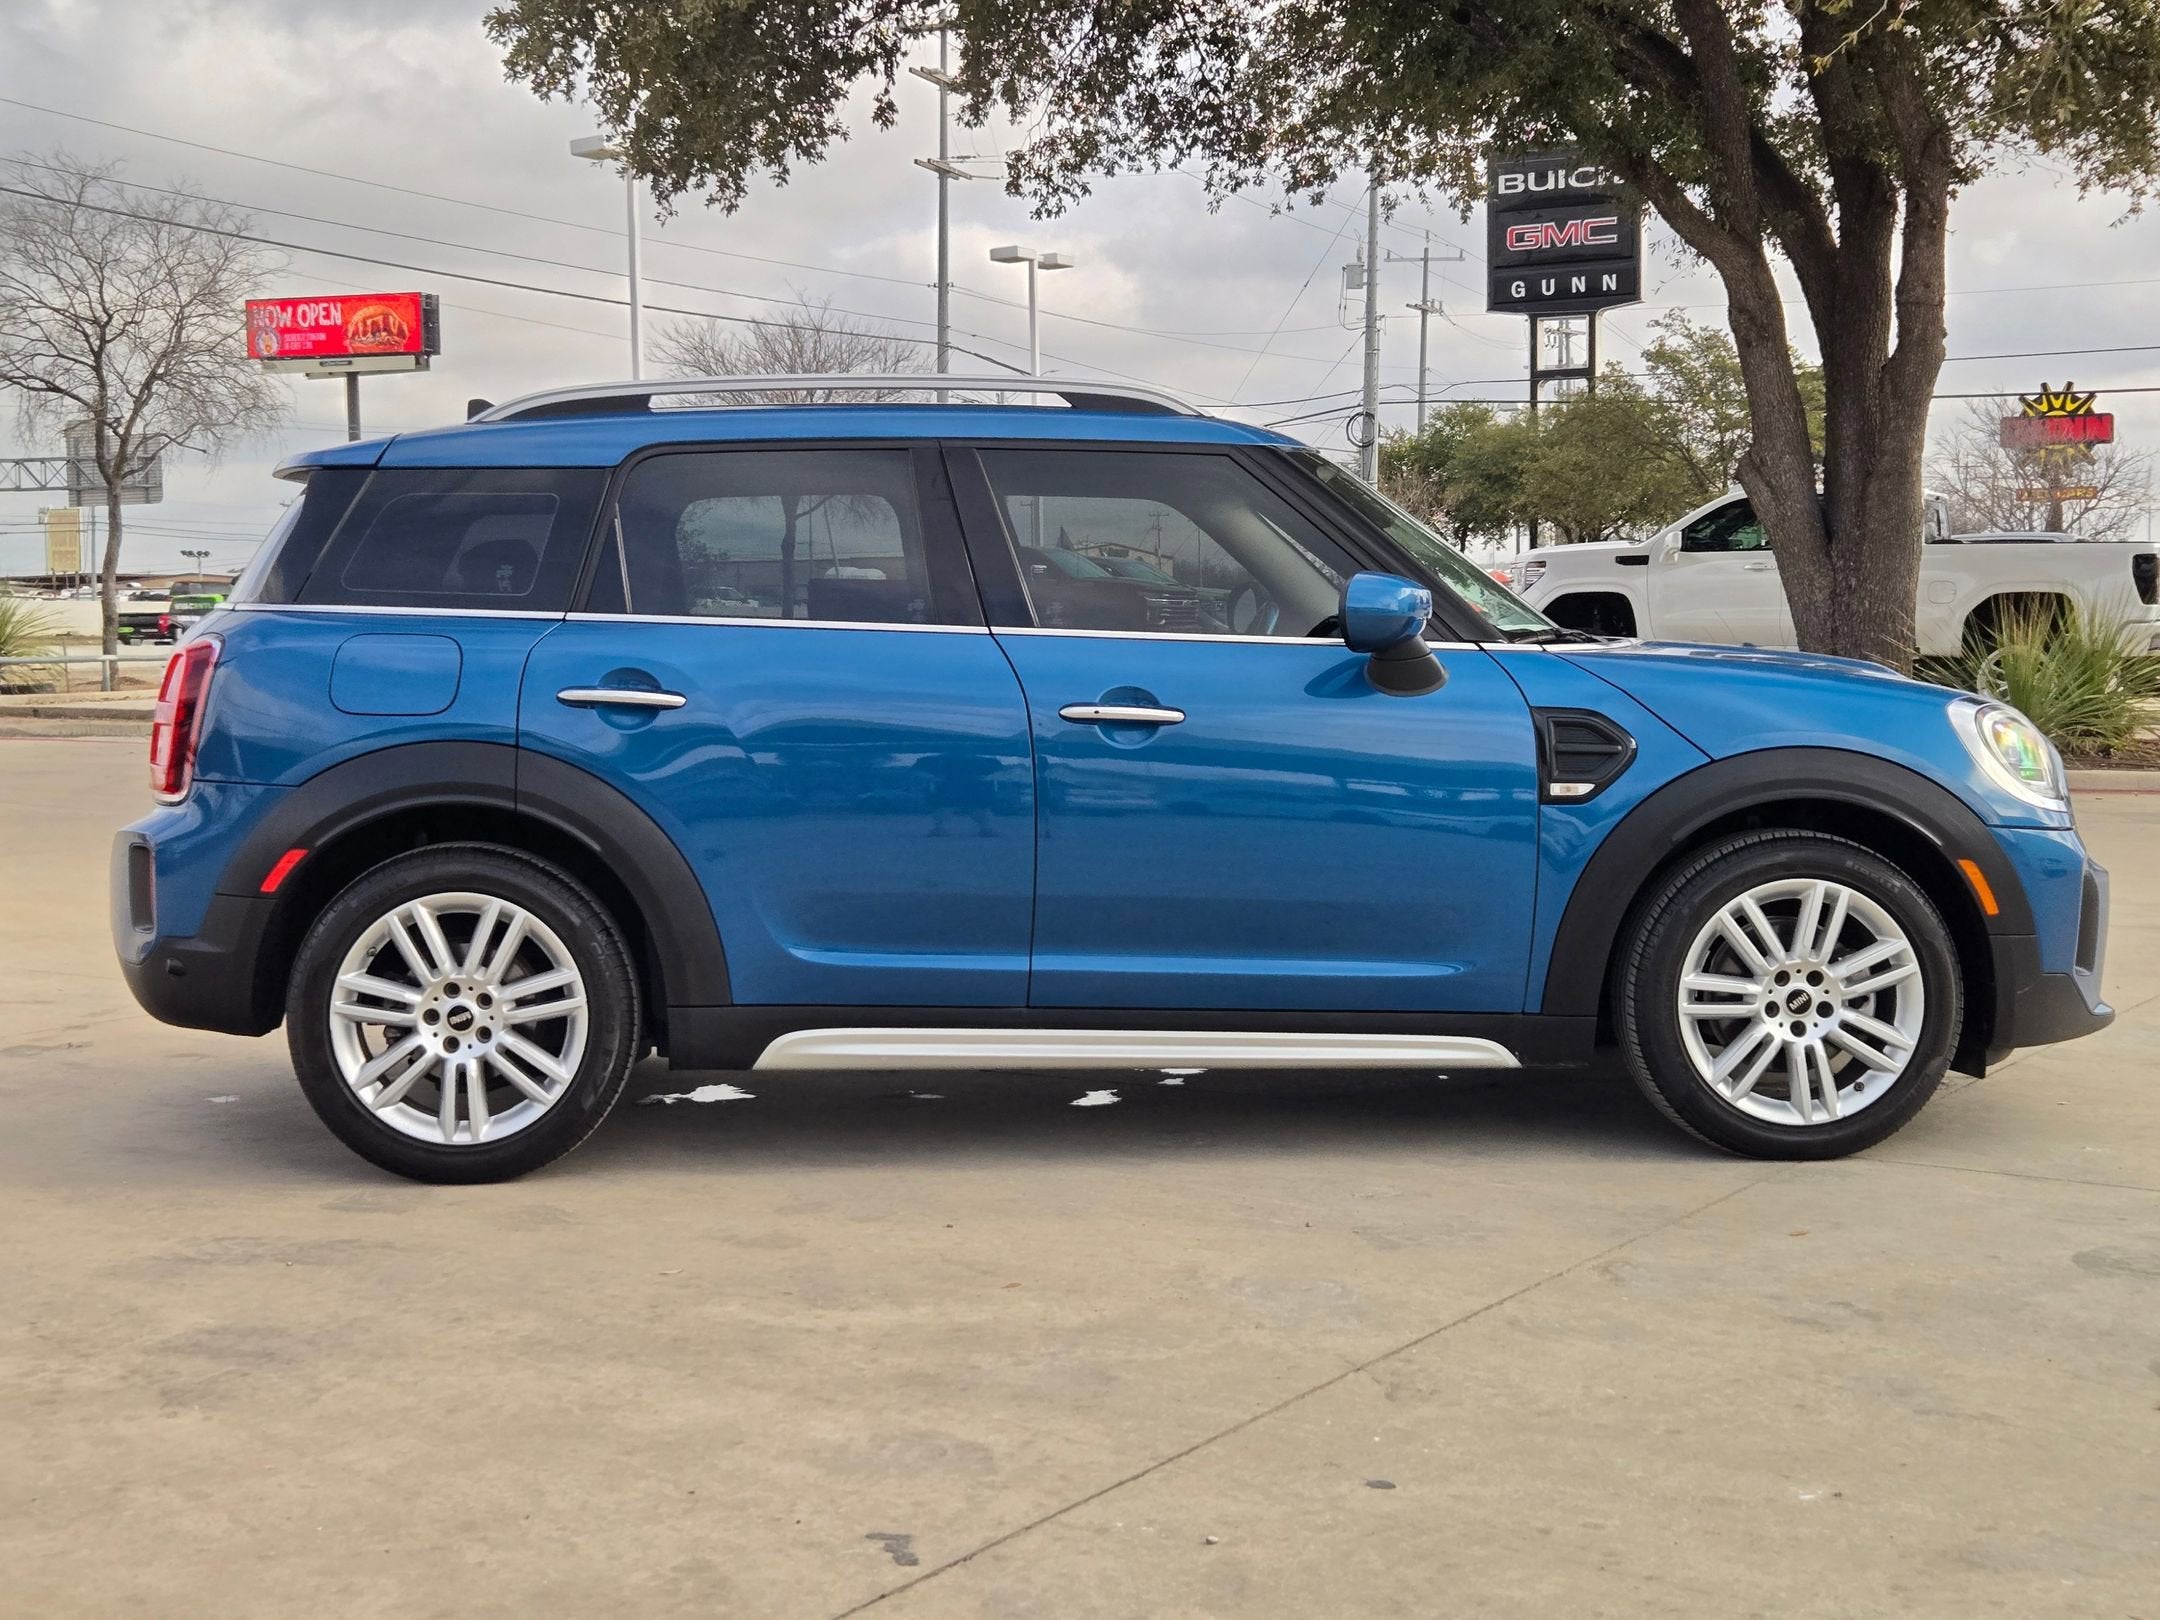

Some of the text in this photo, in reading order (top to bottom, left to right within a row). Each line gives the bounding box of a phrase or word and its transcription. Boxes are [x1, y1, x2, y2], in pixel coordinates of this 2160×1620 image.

[1506, 217, 1618, 251] GMC
[1511, 274, 1617, 298] GUNN
[253, 302, 343, 328] NOW OPEN
[1789, 992, 1809, 1010] MINI
